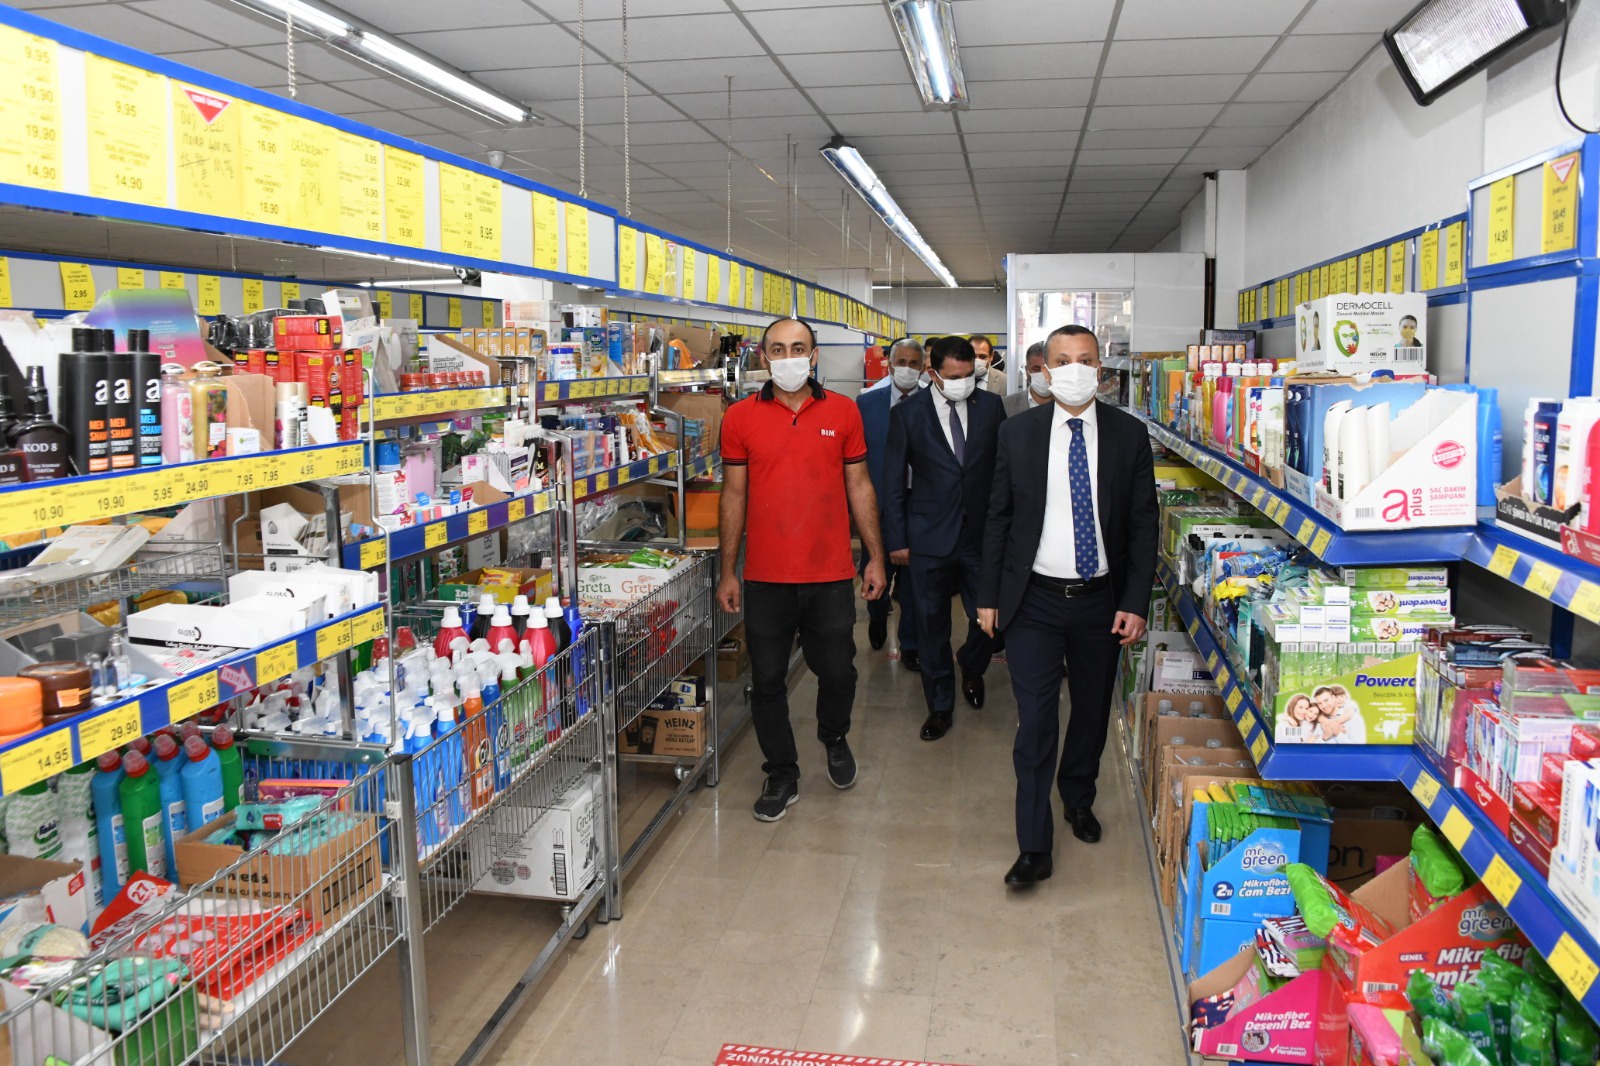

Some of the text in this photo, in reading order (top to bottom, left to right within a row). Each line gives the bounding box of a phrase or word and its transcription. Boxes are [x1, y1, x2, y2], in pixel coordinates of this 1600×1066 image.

[22, 84, 53, 102] 19.90
[115, 100, 137, 118] 9.95
[26, 124, 55, 141] 19.90
[257, 139, 277, 155] 16.90
[26, 163, 56, 180] 14.90
[115, 173, 142, 191] 14.90
[258, 201, 279, 216] 18.90
[74, 290, 88, 298] 2.95
[1336, 301, 1394, 311] DERMOCELL
[109, 418, 126, 428] MEN
[140, 415, 156, 424] MEN
[23, 442, 58, 453] KOD 8
[336, 457, 348, 470] 7.95
[349, 457, 362, 468] 4.95
[263, 470, 279, 482] 7.95
[300, 464, 314, 476] 4.95
[186, 479, 209, 494] 24.90
[237, 473, 254, 486] 7.95
[153, 487, 173, 502] 5.95
[1429, 493, 1466, 501] ŞAMPUANI
[97, 495, 125, 512] 19.90
[1412, 487, 1425, 518] plus
[33, 505, 64, 521] 10.90
[578, 579, 611, 593] Greta
[1399, 599, 1448, 607] Powerdent
[178, 628, 196, 637] GLOSS
[371, 620, 383, 633] 4.95
[337, 632, 350, 646] 5.95
[198, 687, 217, 704] 8.95
[110, 719, 138, 742] 29.90
[664, 718, 696, 730] HEINZ
[37, 747, 69, 771] 14.95
[1242, 854, 1286, 869] green
[131, 881, 150, 902] 27
[1239, 886, 1291, 898] Cam Bezi
[1459, 917, 1514, 935] green
[1399, 954, 1424, 962] GENEL
[1254, 1011, 1310, 1022] Mikrofiber
[1244, 1019, 1312, 1031] Desenli Bez
